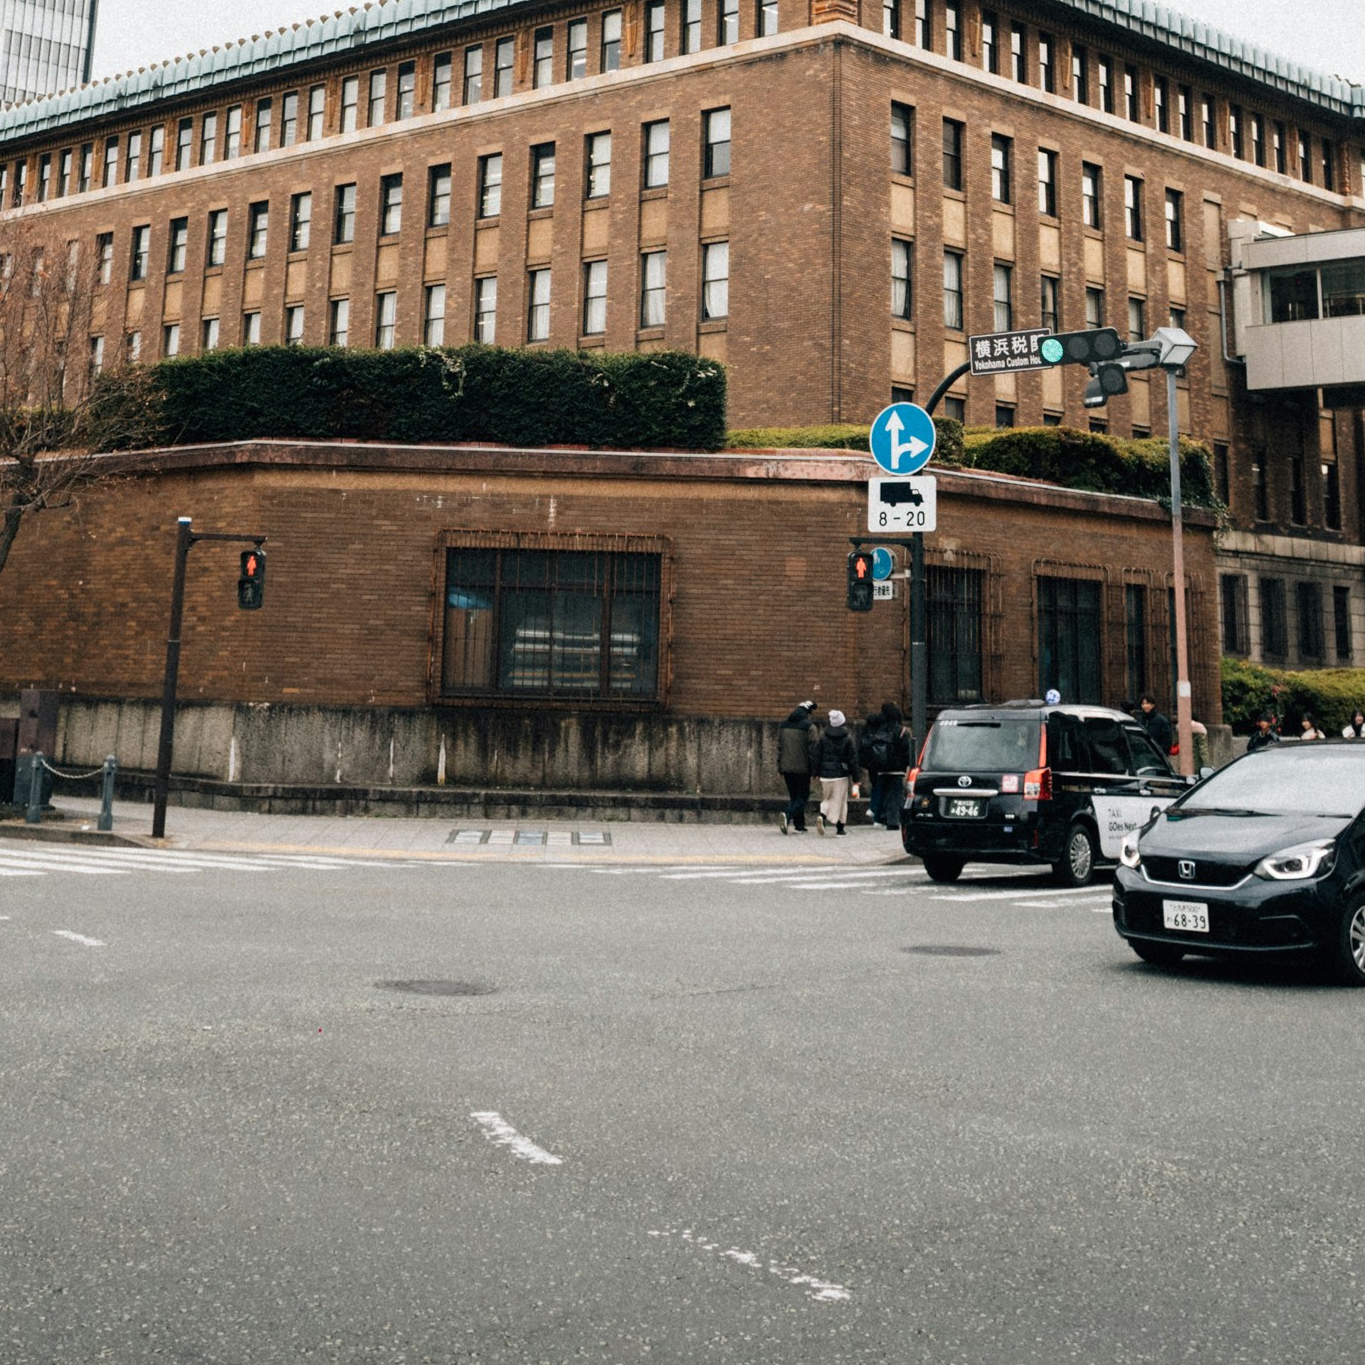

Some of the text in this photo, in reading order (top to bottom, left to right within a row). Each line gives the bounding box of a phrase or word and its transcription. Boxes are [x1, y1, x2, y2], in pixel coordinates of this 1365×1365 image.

[974, 357, 1006, 370] Yokohama
[1006, 356, 1029, 367] Custom
[1174, 914, 1206, 929] 68-39
